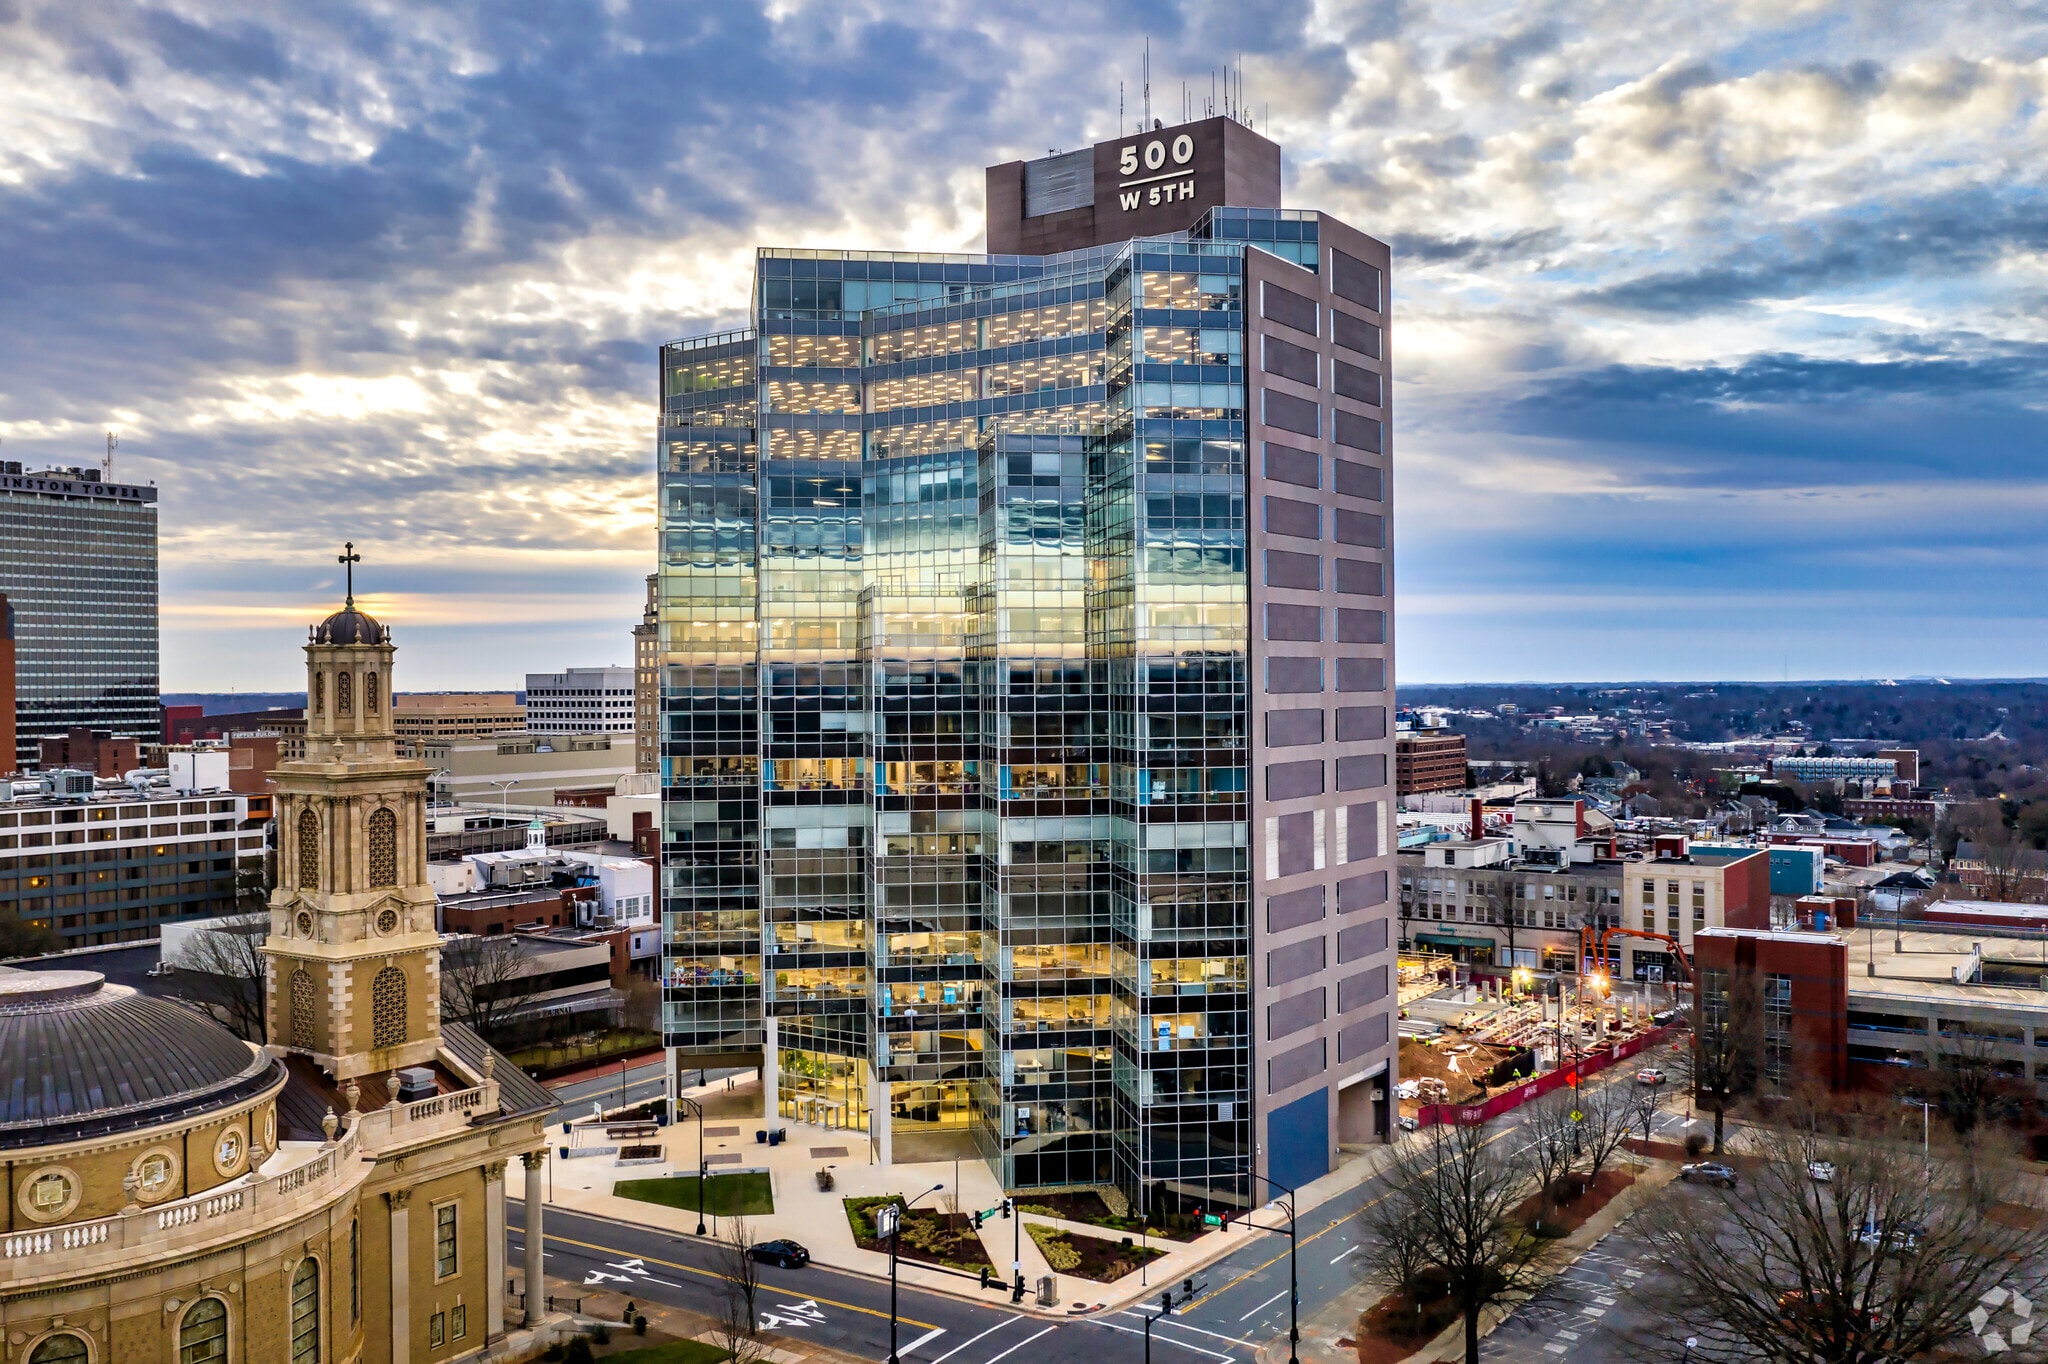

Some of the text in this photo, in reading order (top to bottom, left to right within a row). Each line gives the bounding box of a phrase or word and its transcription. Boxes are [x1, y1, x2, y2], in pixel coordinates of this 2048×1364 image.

[1119, 134, 1194, 175] 500
[1119, 180, 1195, 212] W 5TH
[3, 477, 140, 498] INSTON TOWER
